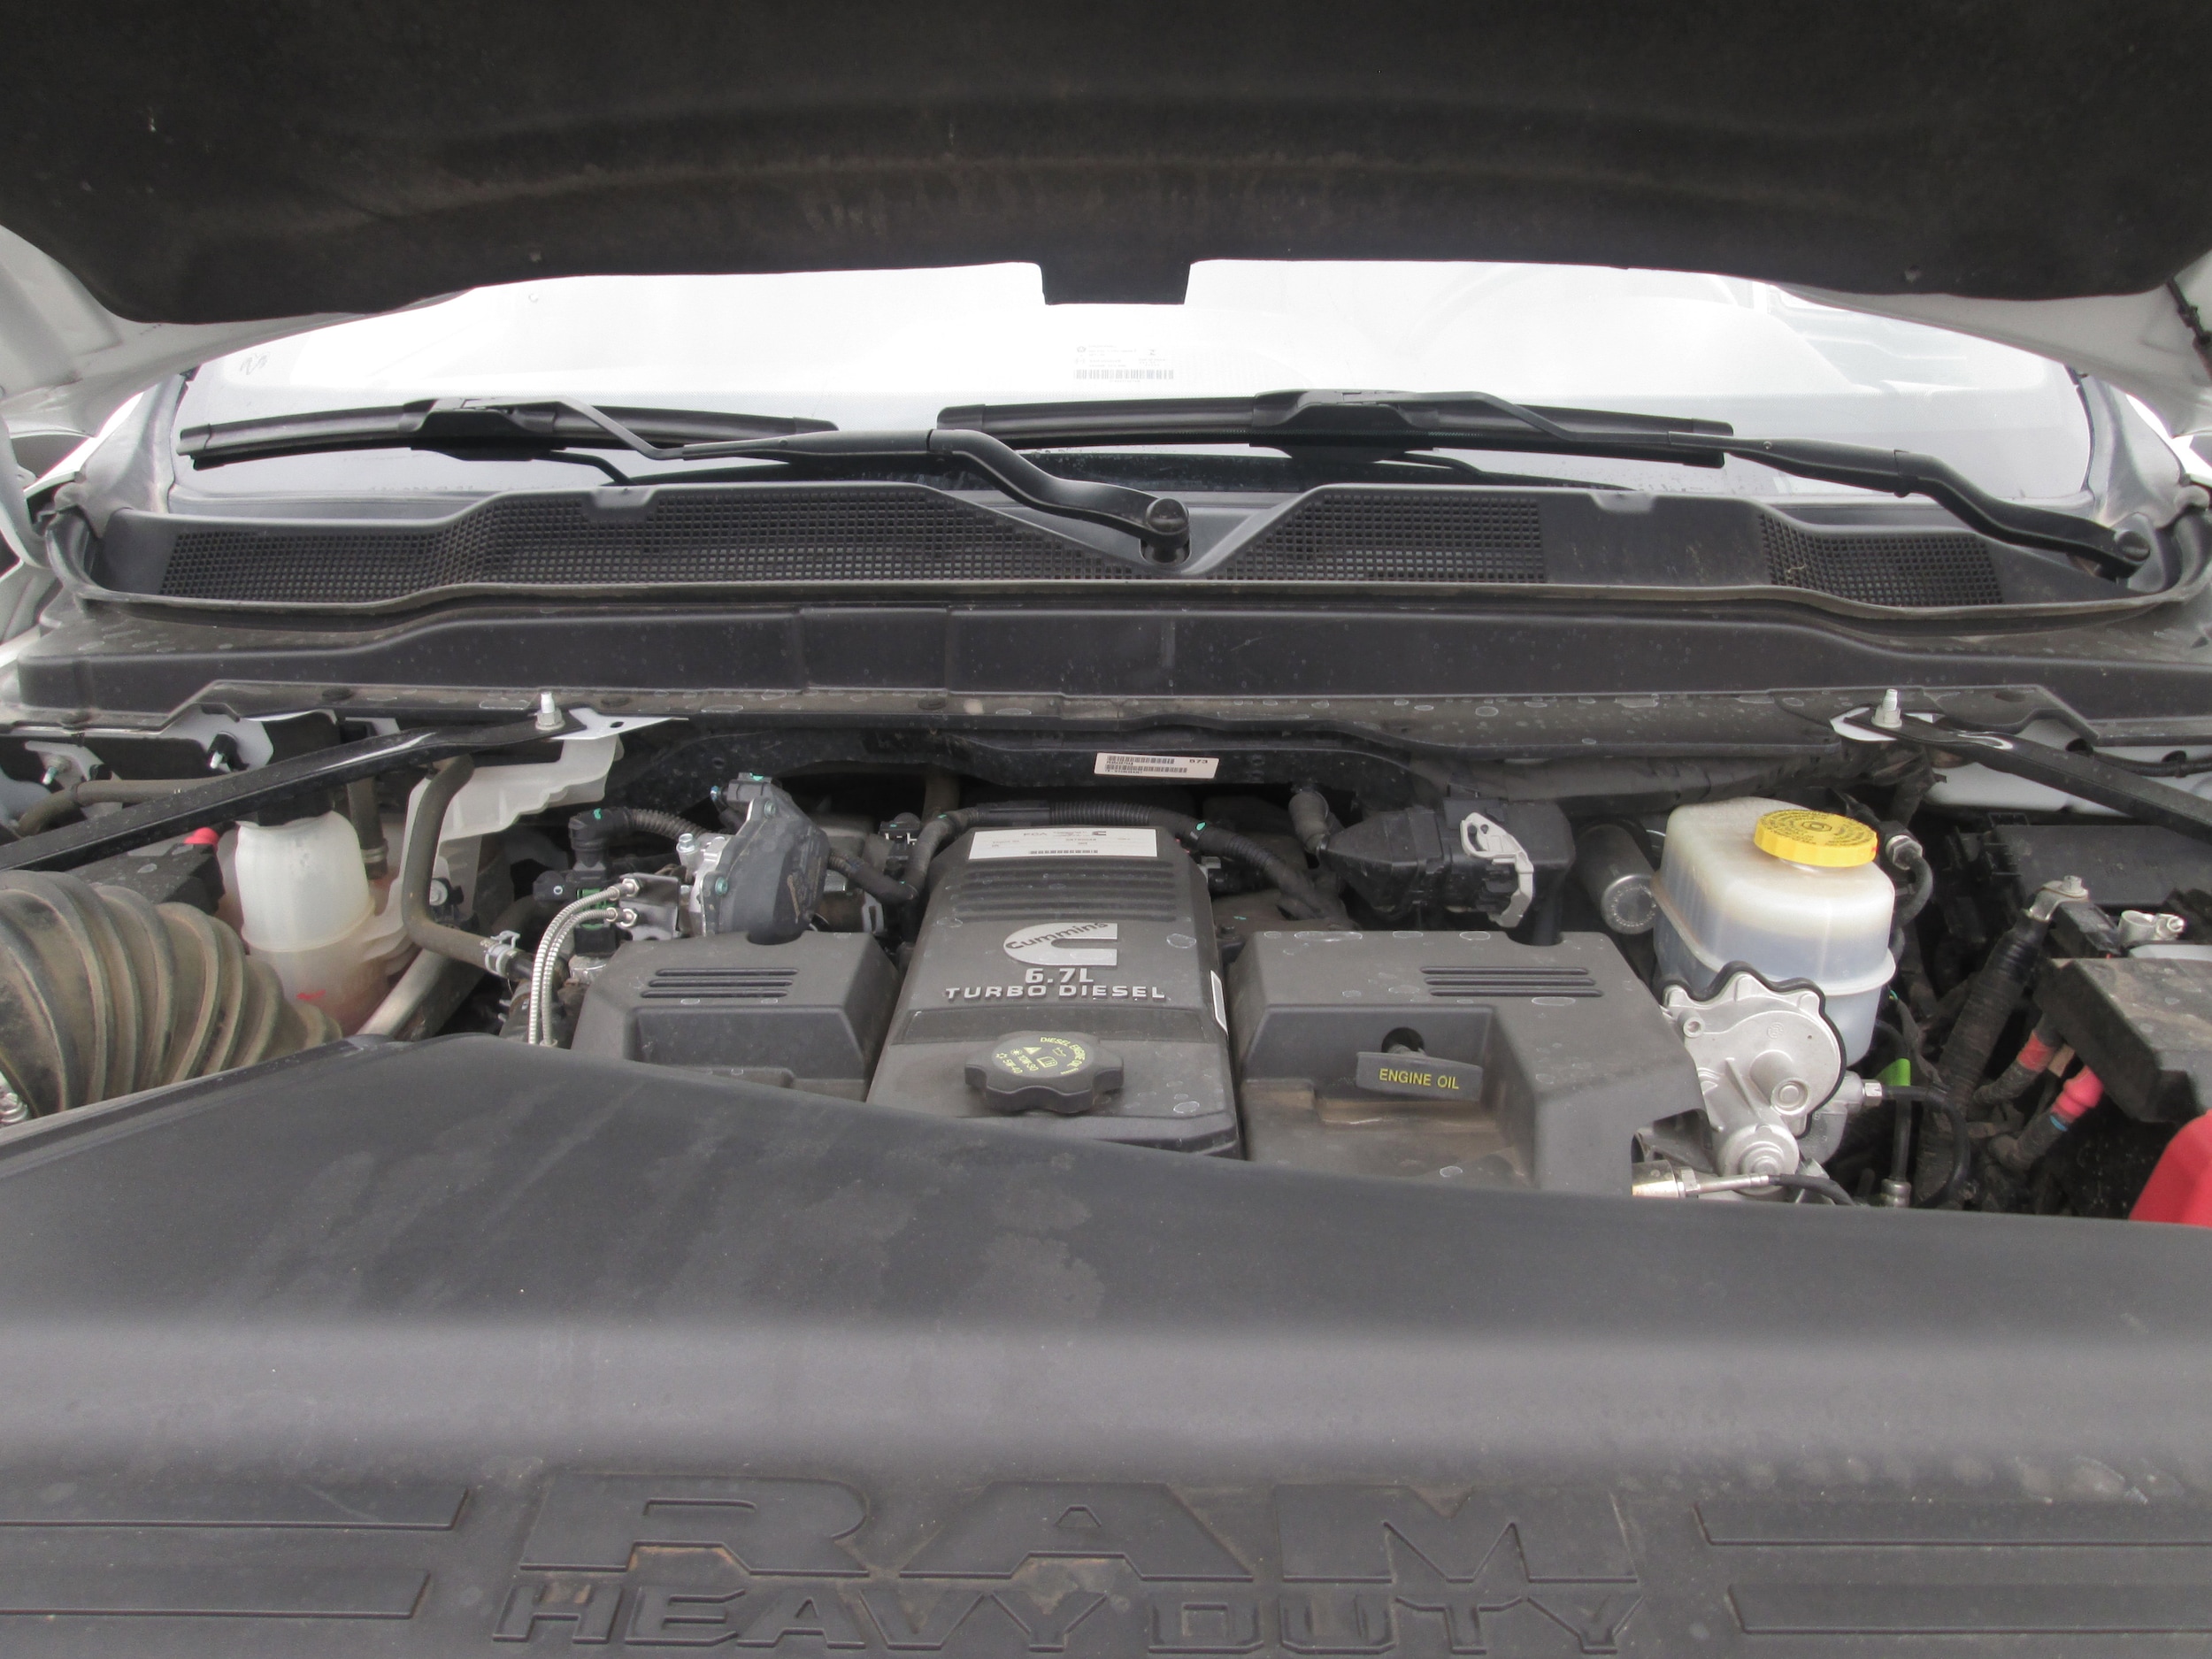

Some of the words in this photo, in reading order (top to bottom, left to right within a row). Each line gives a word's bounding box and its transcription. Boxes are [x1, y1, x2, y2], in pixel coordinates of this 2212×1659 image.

[1005, 923, 1109, 949] Cummins
[1025, 967, 1094, 984] 6.7L
[945, 985, 1047, 1001] TURBO
[1059, 985, 1165, 1000] DIESEL
[1040, 1037, 1071, 1046] DIESEL
[1069, 1044, 1087, 1061] ENGINE
[1379, 1068, 1432, 1086] ENGINE
[1437, 1075, 1459, 1089] OIL
[518, 1472, 1638, 1584] RAM
[492, 1587, 1109, 1653] HEAVY
[1148, 1593, 1645, 1655] DUTY
